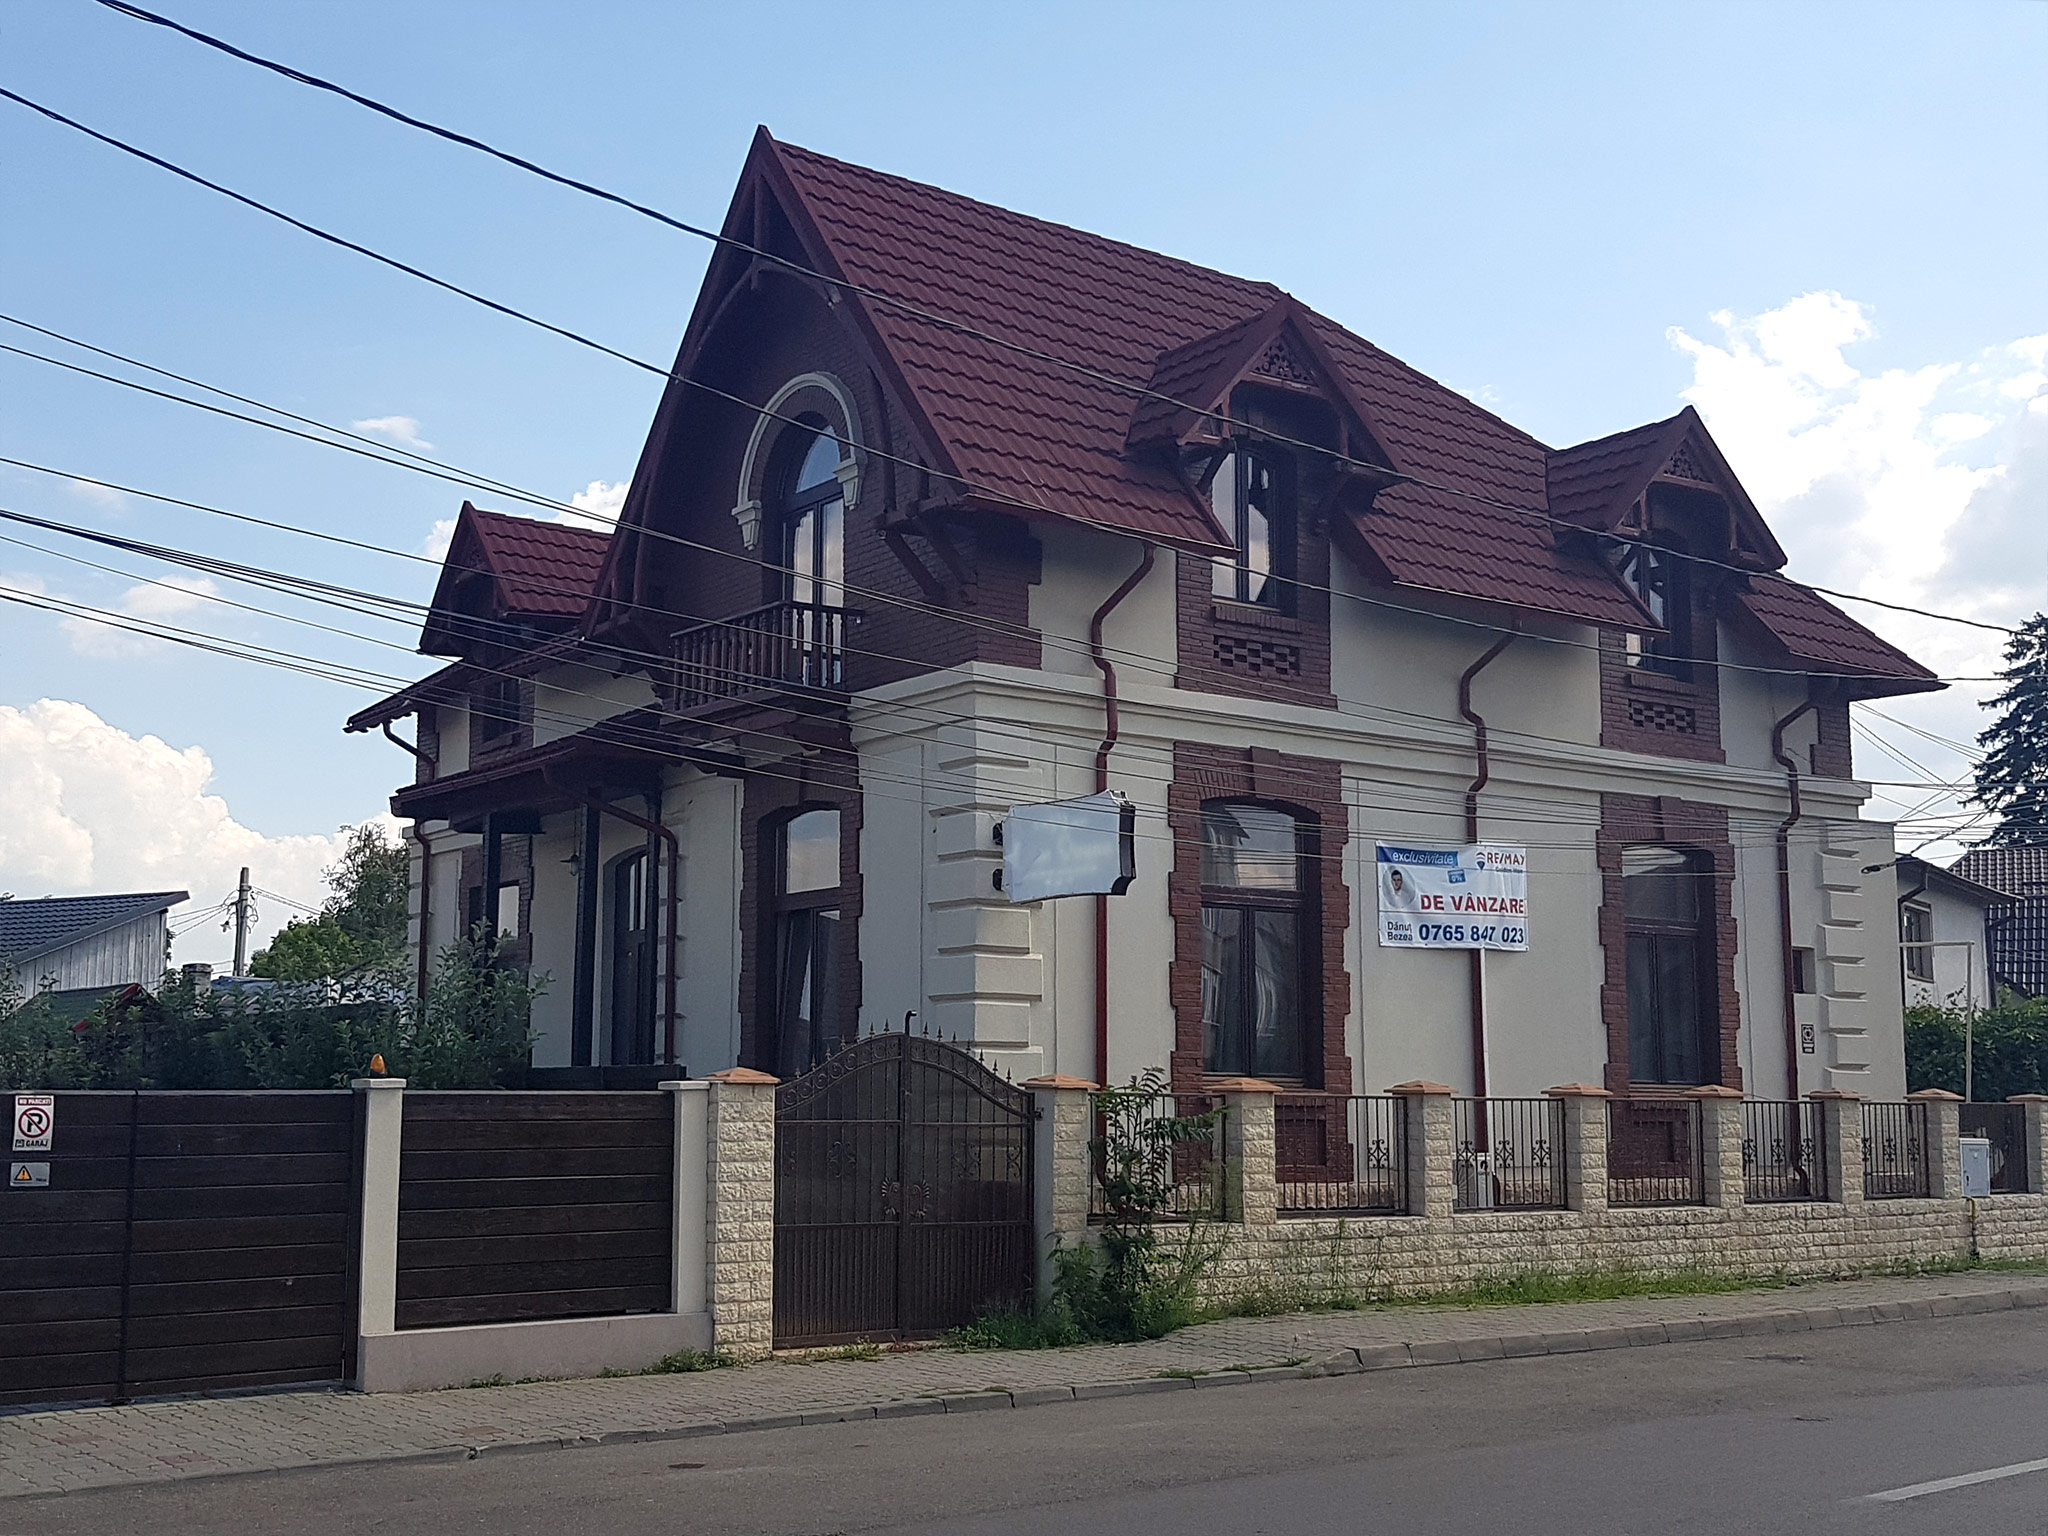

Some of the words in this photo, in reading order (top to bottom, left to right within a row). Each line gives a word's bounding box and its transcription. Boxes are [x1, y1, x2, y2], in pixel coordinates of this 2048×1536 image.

[1392, 851, 1453, 865] exclusivitate
[1421, 895, 1445, 911] DE
[1450, 892, 1524, 914] VÂNZARE
[1388, 932, 1412, 941] Bezea
[1419, 924, 1464, 941] 0765
[1471, 926, 1496, 942] 847
[1501, 927, 1524, 943] 023
